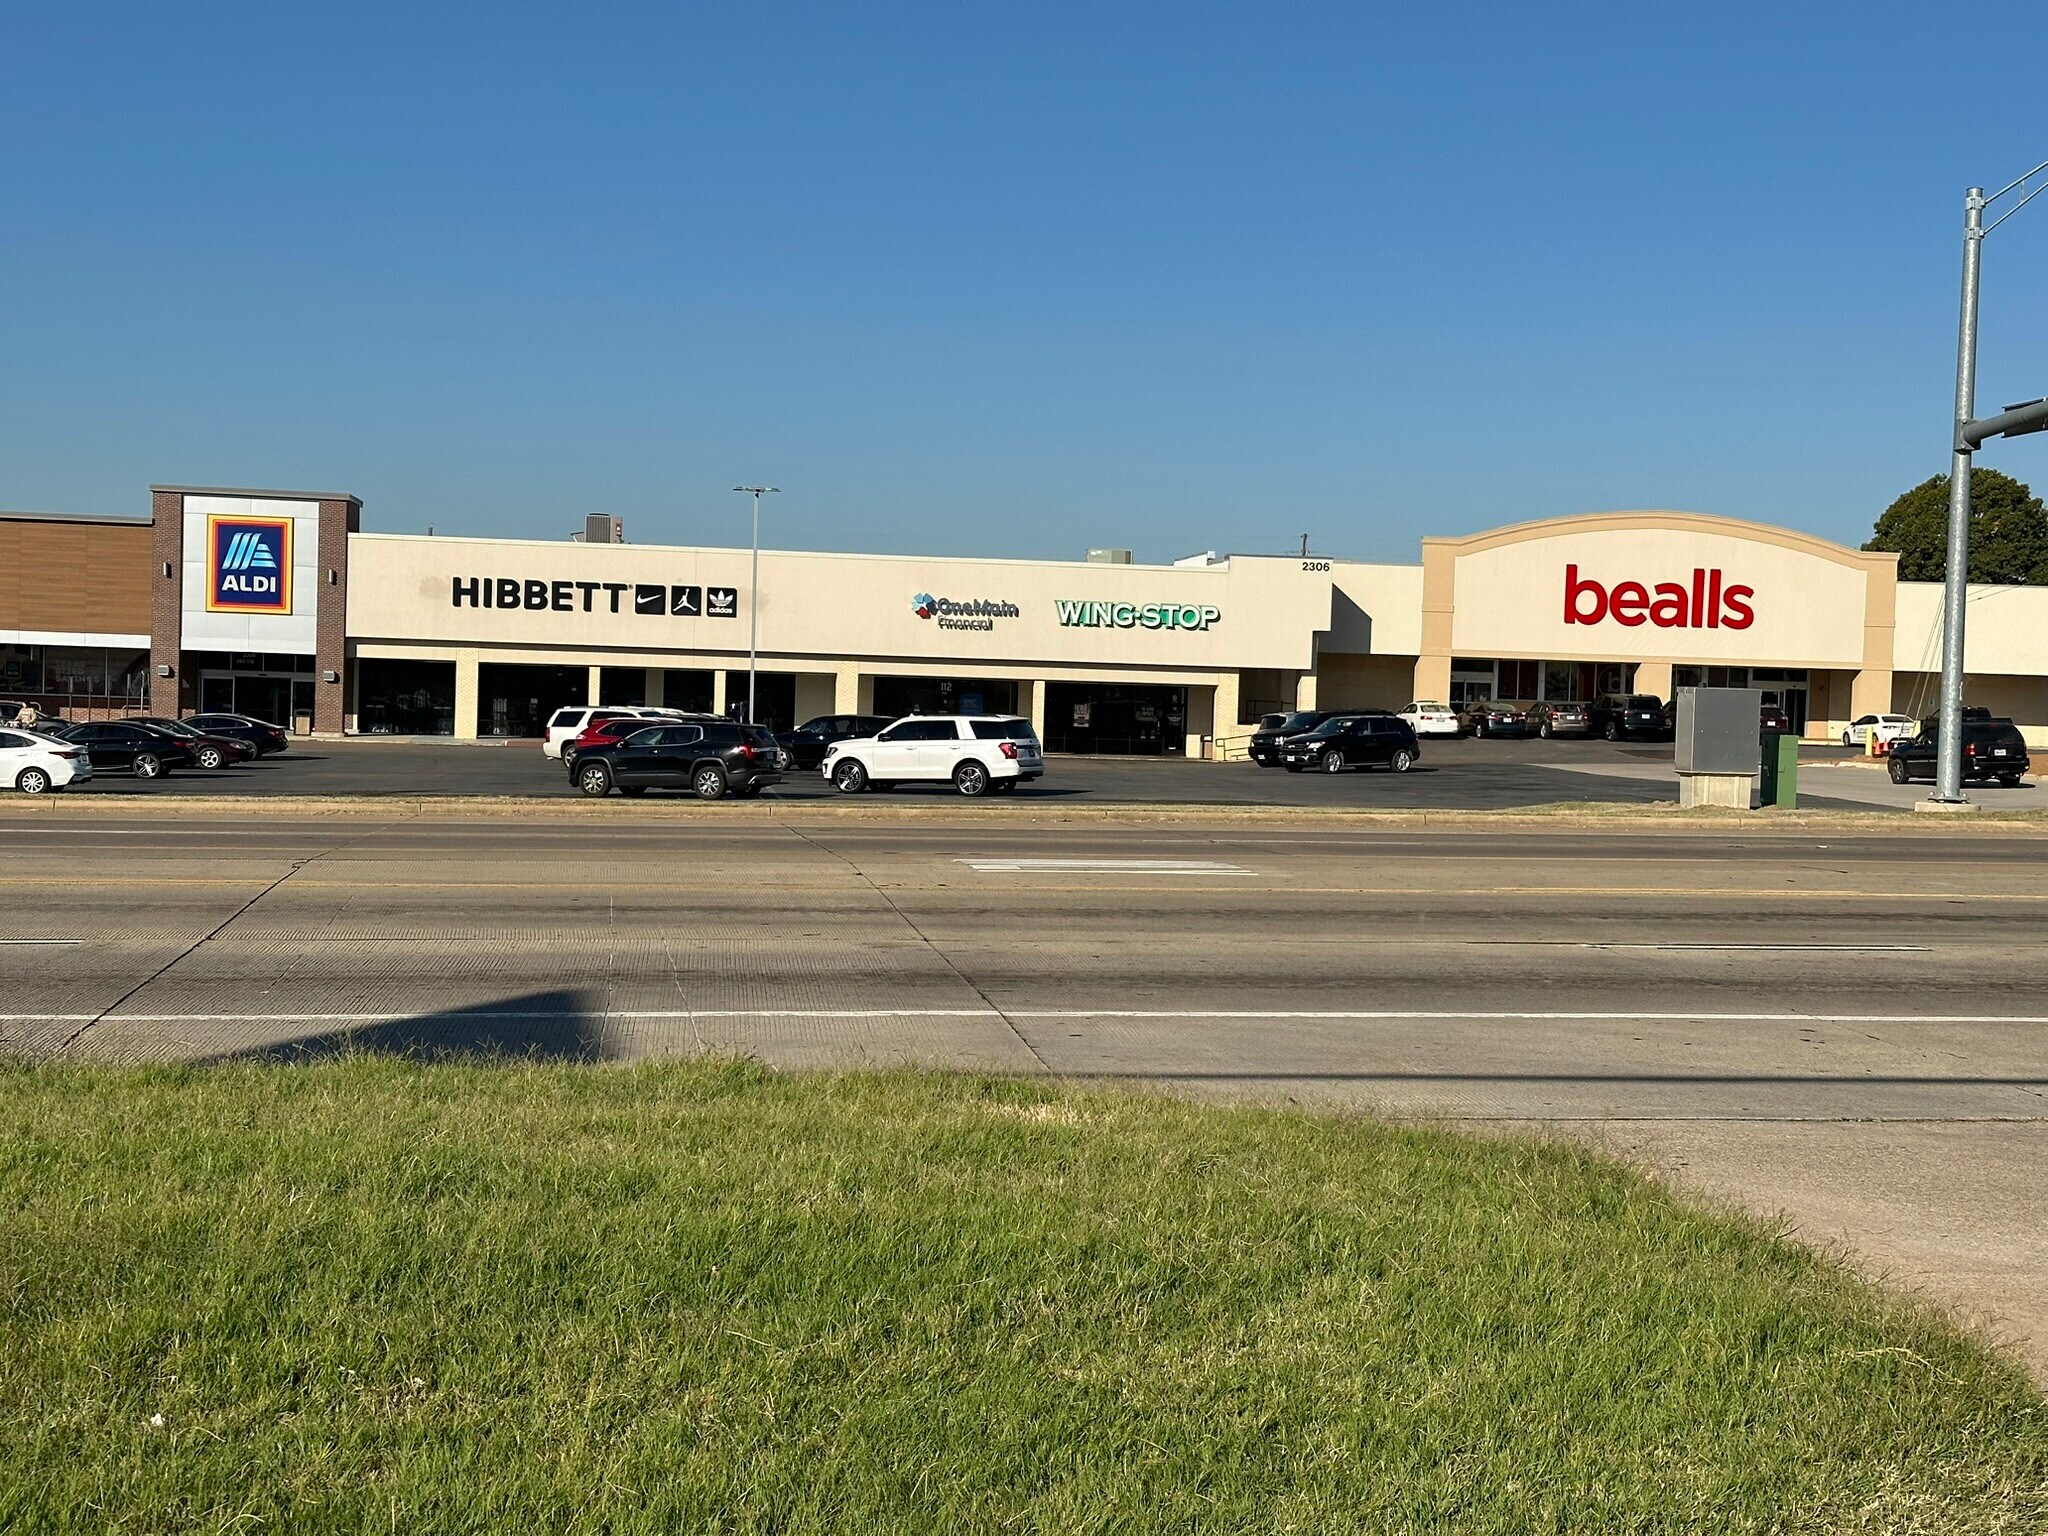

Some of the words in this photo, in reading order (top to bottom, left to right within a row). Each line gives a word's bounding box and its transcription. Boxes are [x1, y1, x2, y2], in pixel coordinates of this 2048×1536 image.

[1302, 562, 1330, 571] 2306
[221, 575, 276, 592] ALDI
[452, 577, 628, 613] HIBBETT
[1564, 564, 1755, 630] bealls
[938, 597, 1019, 618] OneMain
[938, 615, 993, 631] Financial
[940, 682, 953, 692] 112
